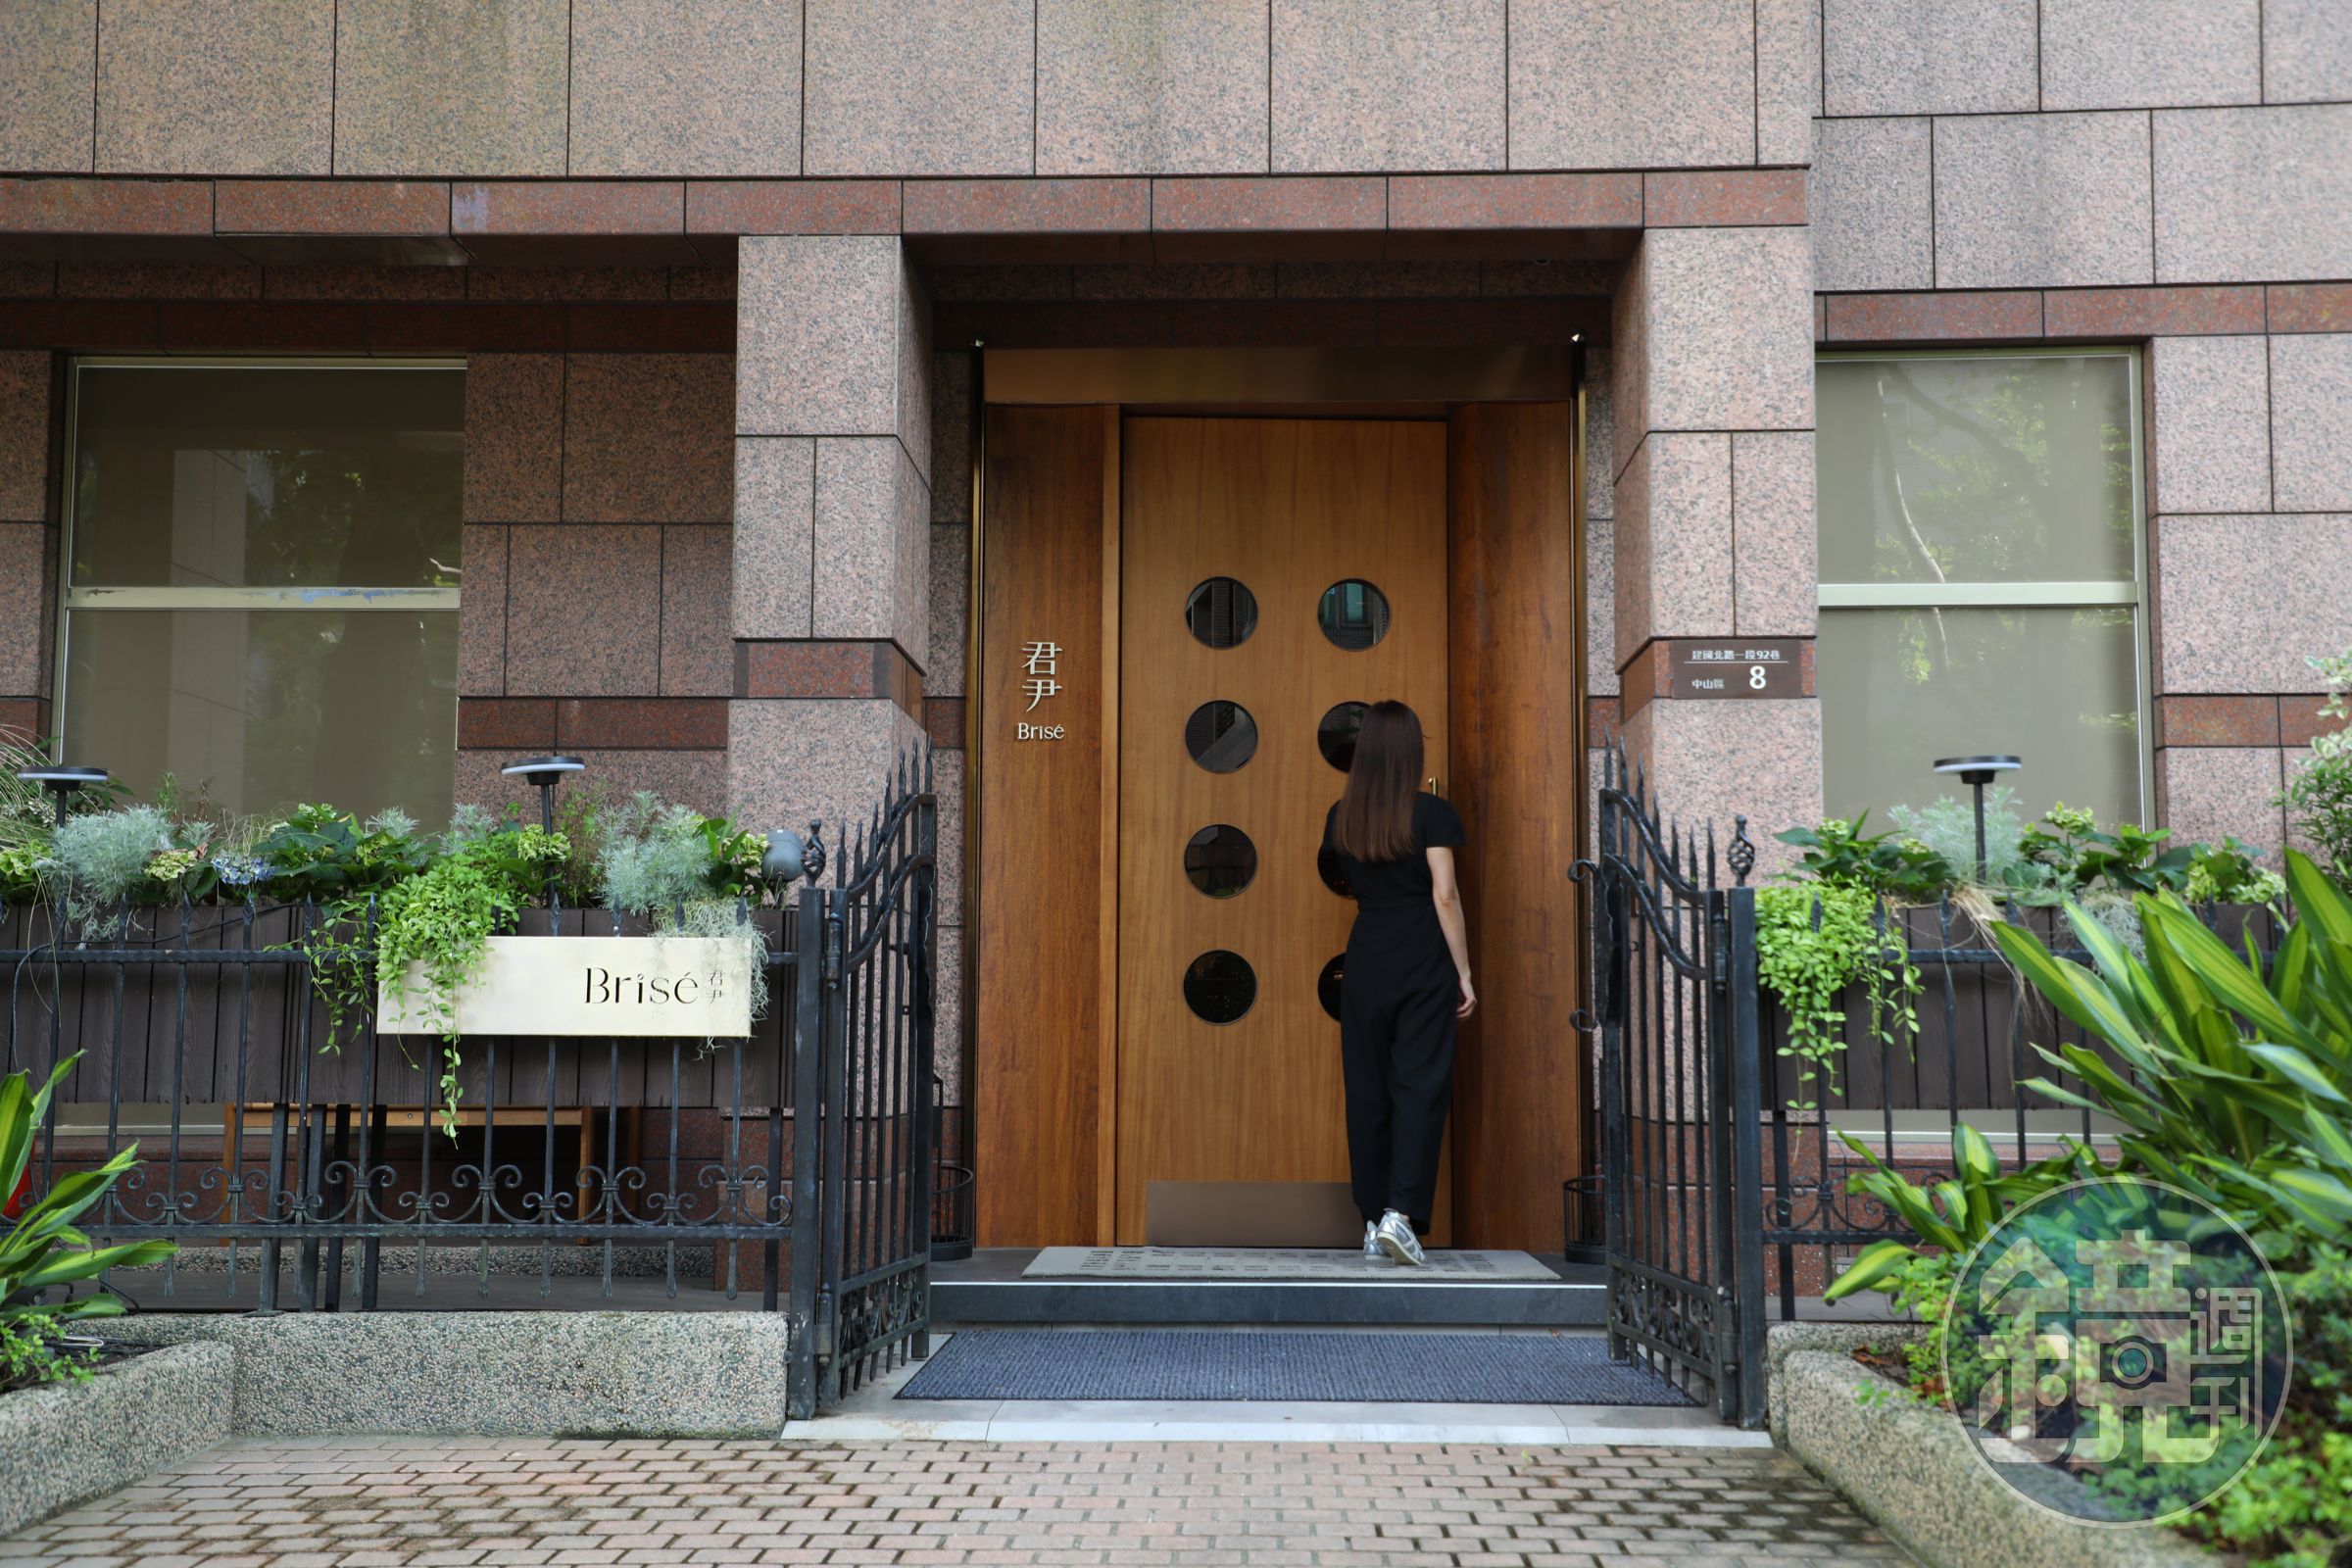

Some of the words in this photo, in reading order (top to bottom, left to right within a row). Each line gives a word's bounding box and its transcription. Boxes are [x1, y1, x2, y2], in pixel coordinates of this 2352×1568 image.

[1021, 641, 1063, 713] 君尹
[1691, 678, 1724, 689] 中山區
[1749, 665, 1766, 689] 8
[1017, 722, 1065, 740] Brisé
[585, 967, 699, 1004] Brisé
[706, 969, 725, 1005] 君尹
